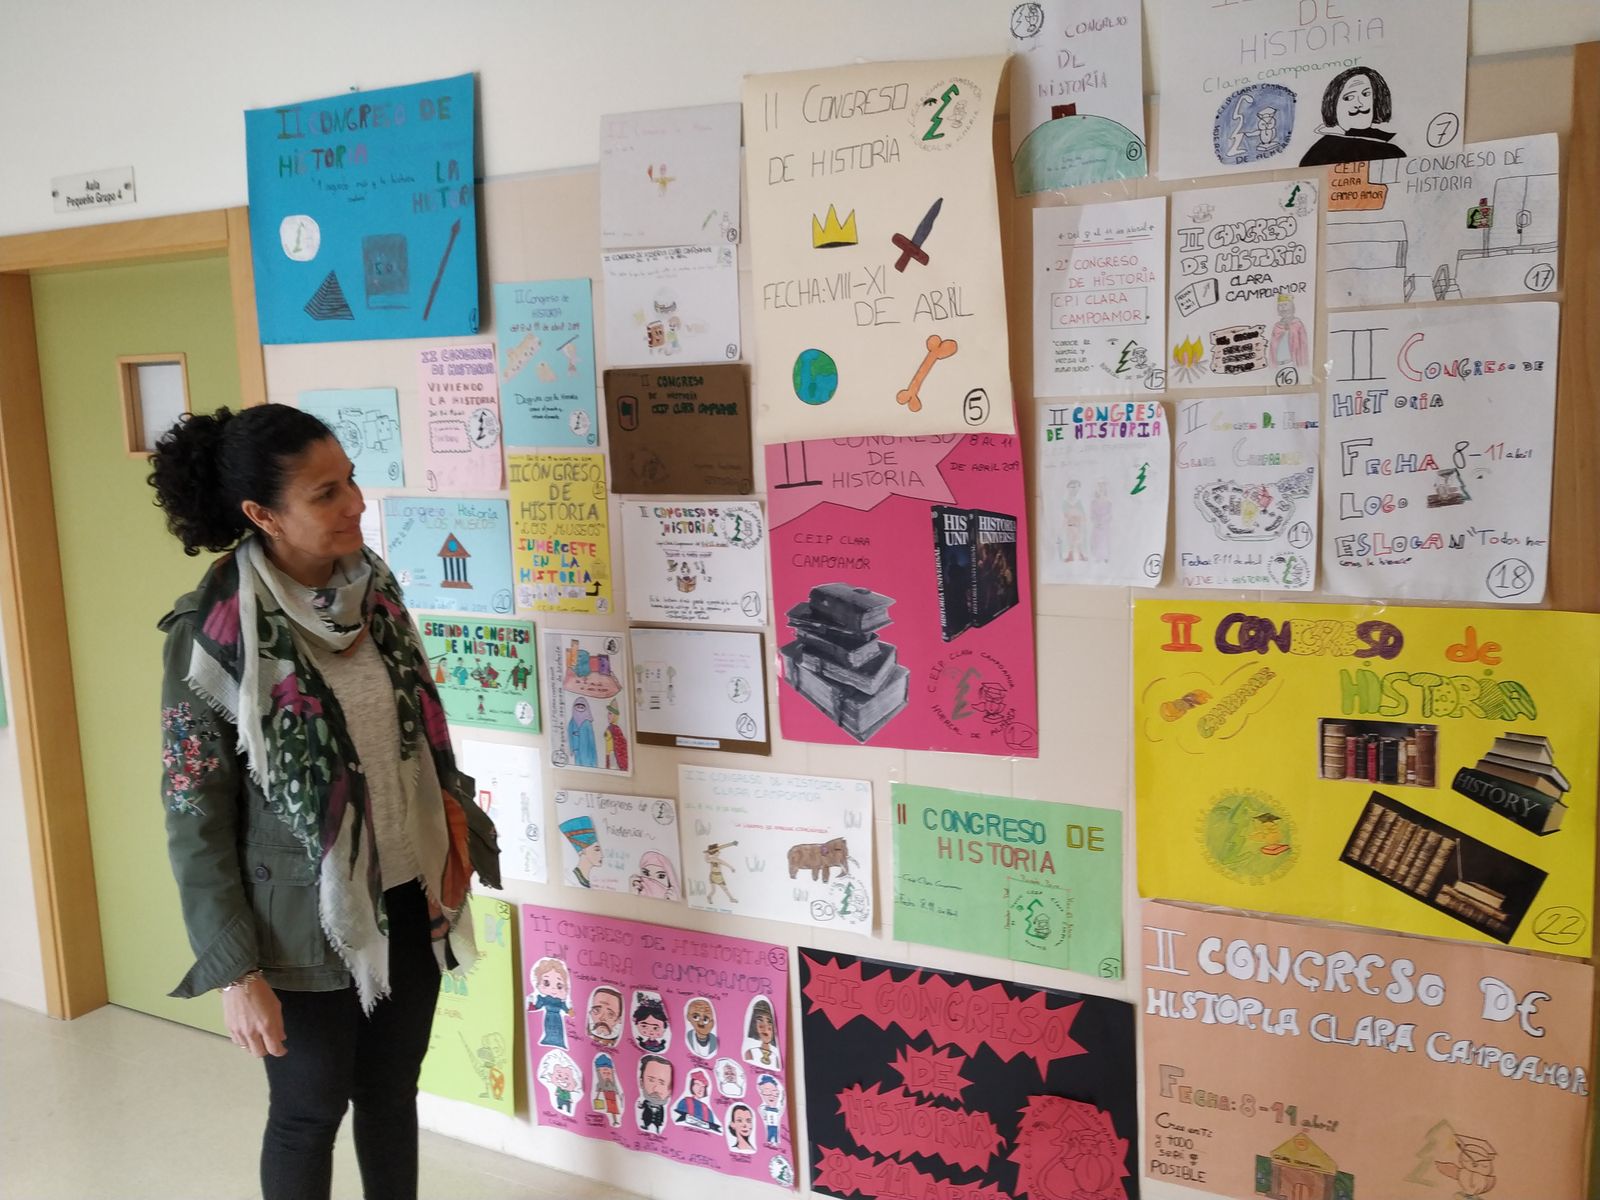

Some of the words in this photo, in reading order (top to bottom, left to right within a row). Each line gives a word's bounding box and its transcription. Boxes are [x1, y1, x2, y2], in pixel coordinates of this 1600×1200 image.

[1202, 74, 1251, 94] Clara
[769, 154, 795, 185] DE
[1406, 152, 1496, 174] CONGRESO
[1504, 148, 1525, 165] DE
[86, 180, 100, 191] Aula
[1331, 178, 1362, 187] CLARA
[1406, 176, 1473, 194] HISTORIA
[1177, 227, 1205, 253] II
[1073, 255, 1139, 270] CONGRESO
[1181, 255, 1208, 276] DE
[1069, 278, 1085, 289] DE
[1230, 274, 1273, 287] CLARA
[1085, 292, 1128, 305] CLARA
[854, 297, 901, 326] DE
[1060, 310, 1142, 325] CAMPOAMOR
[1330, 327, 1389, 381] II
[428, 382, 483, 392] VIVIENDO
[429, 397, 446, 406] LA
[1048, 409, 1069, 426] II
[1182, 401, 1207, 434] II
[1047, 428, 1064, 441] DE
[1075, 422, 1161, 440] HISTORIA
[867, 451, 898, 466] DE
[950, 461, 966, 471] DE
[972, 461, 999, 471] ABRIL
[522, 463, 601, 482] CONGRESO
[832, 470, 925, 489] HISTORIA
[550, 483, 572, 501] DE
[521, 501, 599, 521] HISTORIA
[708, 508, 720, 517] DE
[794, 533, 834, 545] CEIP
[840, 535, 871, 546] CLARA
[533, 555, 549, 567] EN
[561, 555, 579, 568] LA
[792, 553, 871, 570] CAMPOAMOR
[520, 568, 592, 583] HISTORIA
[445, 639, 458, 653] DE
[1160, 613, 1203, 653] II
[1214, 612, 1404, 660] CONGRESO
[1445, 626, 1502, 665] de
[1458, 772, 1540, 818] HISTORY
[897, 803, 906, 825] II
[923, 807, 1046, 845] CONGRESO
[1066, 824, 1104, 852] DE
[938, 836, 1056, 875] HISTORIA
[1536, 913, 1580, 935] 22
[530, 914, 552, 934] II
[557, 920, 633, 947] CONGRESO
[641, 935, 665, 951] DE
[671, 939, 769, 967] HISTORIA
[1143, 926, 1190, 976] II
[577, 949, 634, 976] CLARA
[651, 961, 774, 994] CAMPOAMOR
[815, 974, 863, 1010] II
[876, 982, 1065, 1053] CONGRESO
[1309, 1012, 1416, 1053] CLARA
[910, 1056, 957, 1092] DE
[1151, 1159, 1207, 1183] POSIBLE
